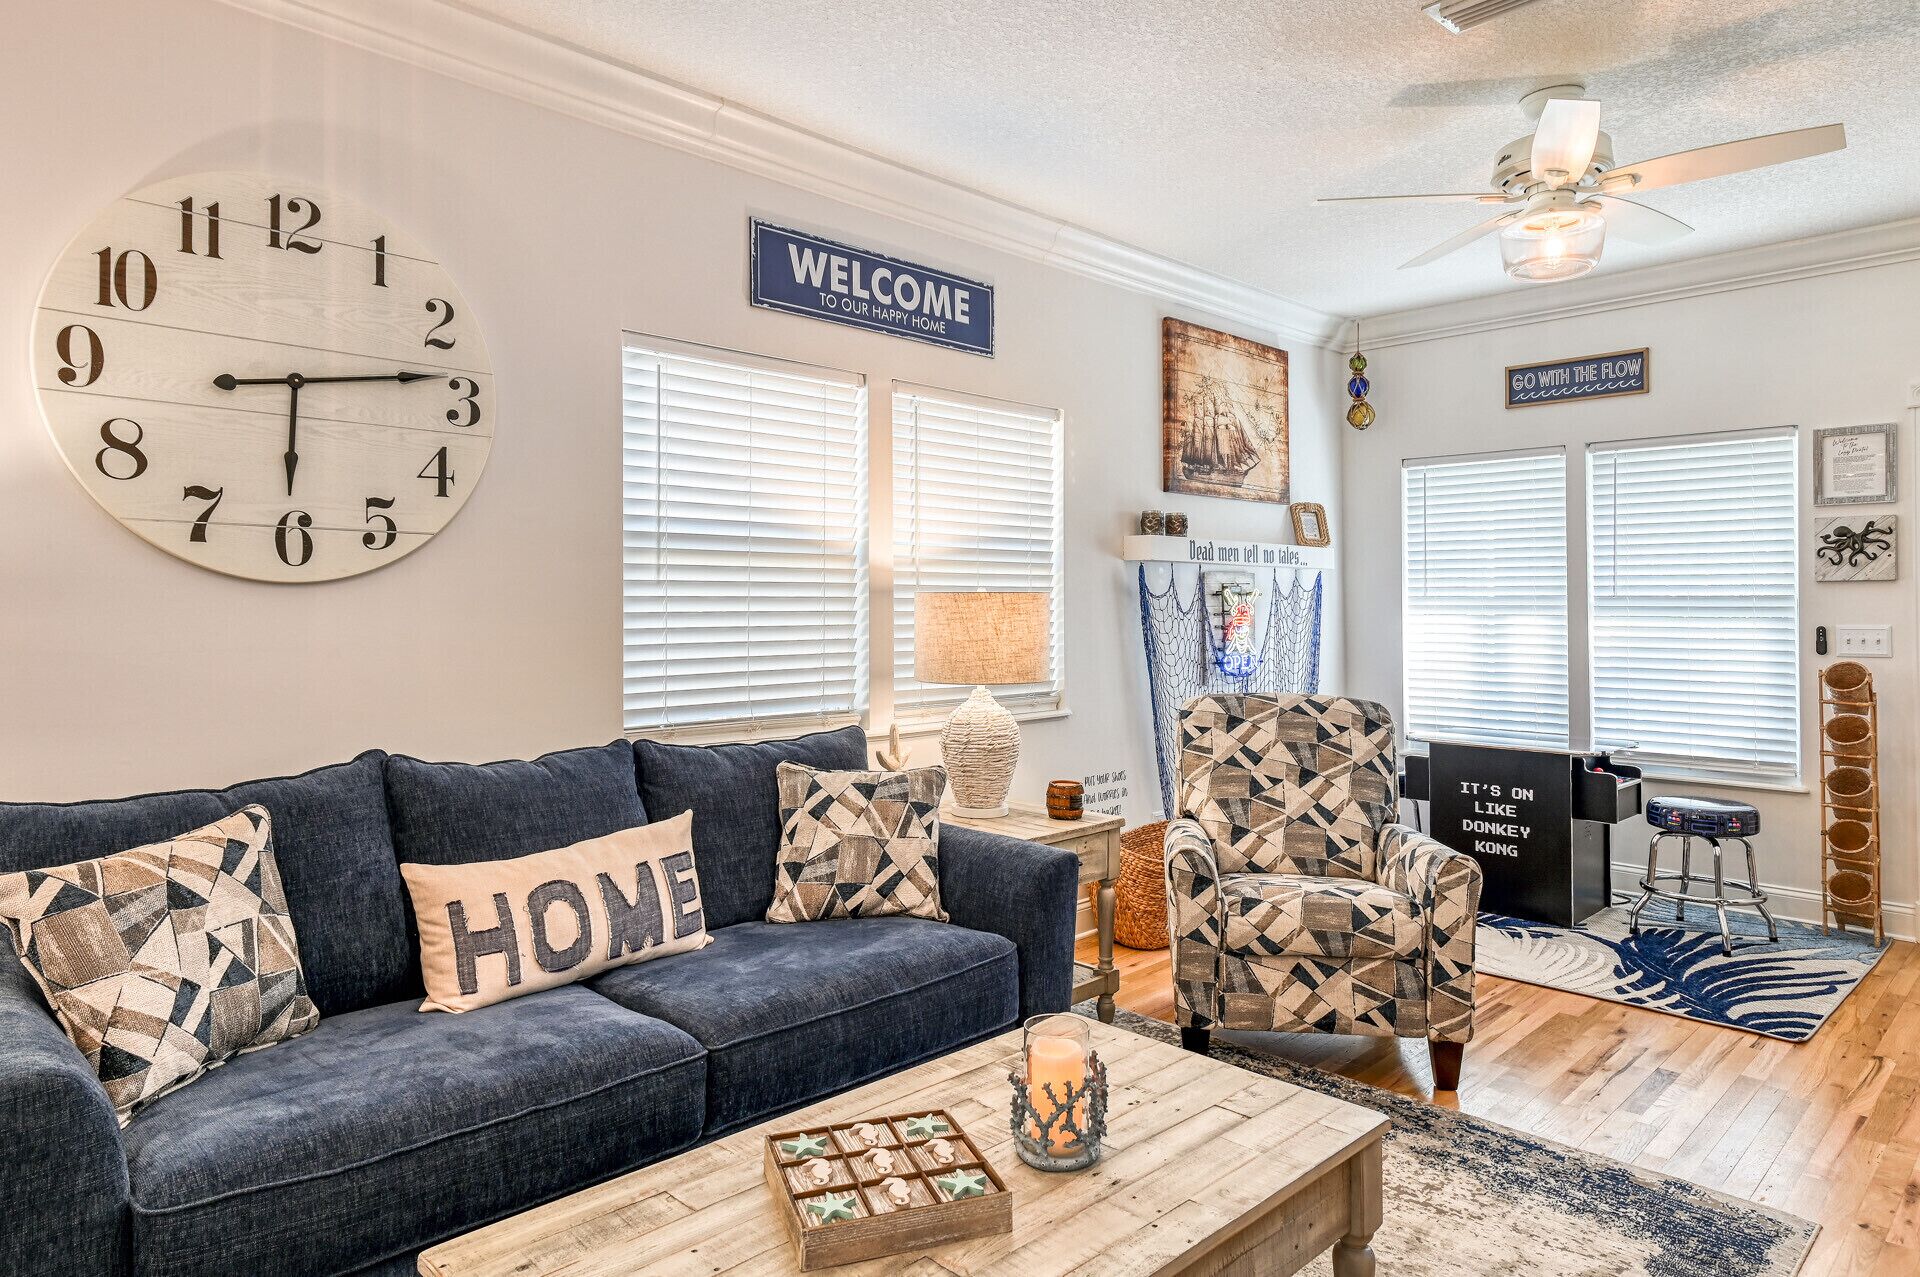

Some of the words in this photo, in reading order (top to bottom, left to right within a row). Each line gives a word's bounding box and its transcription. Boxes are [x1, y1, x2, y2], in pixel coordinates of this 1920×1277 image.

[175, 196, 223, 260] 11
[264, 193, 322, 254] 12
[92, 245, 158, 312] 10
[370, 235, 388, 287] 1
[788, 243, 970, 324] WELCOME
[424, 298, 456, 350] 2
[820, 292, 837, 308] TO
[842, 298, 869, 316] OUR
[873, 305, 909, 325] HAPPY
[913, 316, 945, 334] HOME
[56, 324, 105, 387] 9
[1513, 373, 1535, 390] GO
[1538, 368, 1569, 387] WITH
[1574, 364, 1597, 382] THE
[1602, 358, 1641, 379] FLOW
[446, 376, 481, 427] 3
[95, 417, 148, 480] 8
[417, 446, 455, 498] 4
[183, 485, 223, 543] 7
[275, 510, 314, 567] 6
[362, 496, 397, 551] 5
[1189, 540, 1214, 561] Dead
[1218, 546, 1239, 562] men
[1244, 545, 1258, 563] tell
[1264, 549, 1274, 563] no
[1278, 547, 1307, 566] tales...
[1224, 655, 1258, 670] OPEN
[1084, 775, 1095, 787] PUT
[1097, 773, 1110, 784] YOUR
[1461, 782, 1500, 797] IT'S
[1512, 788, 1534, 801] ON
[1463, 819, 1530, 839] DONKEY
[1475, 802, 1516, 817] LIKE
[1475, 840, 1518, 857] KONG
[445, 850, 703, 995] HOME
